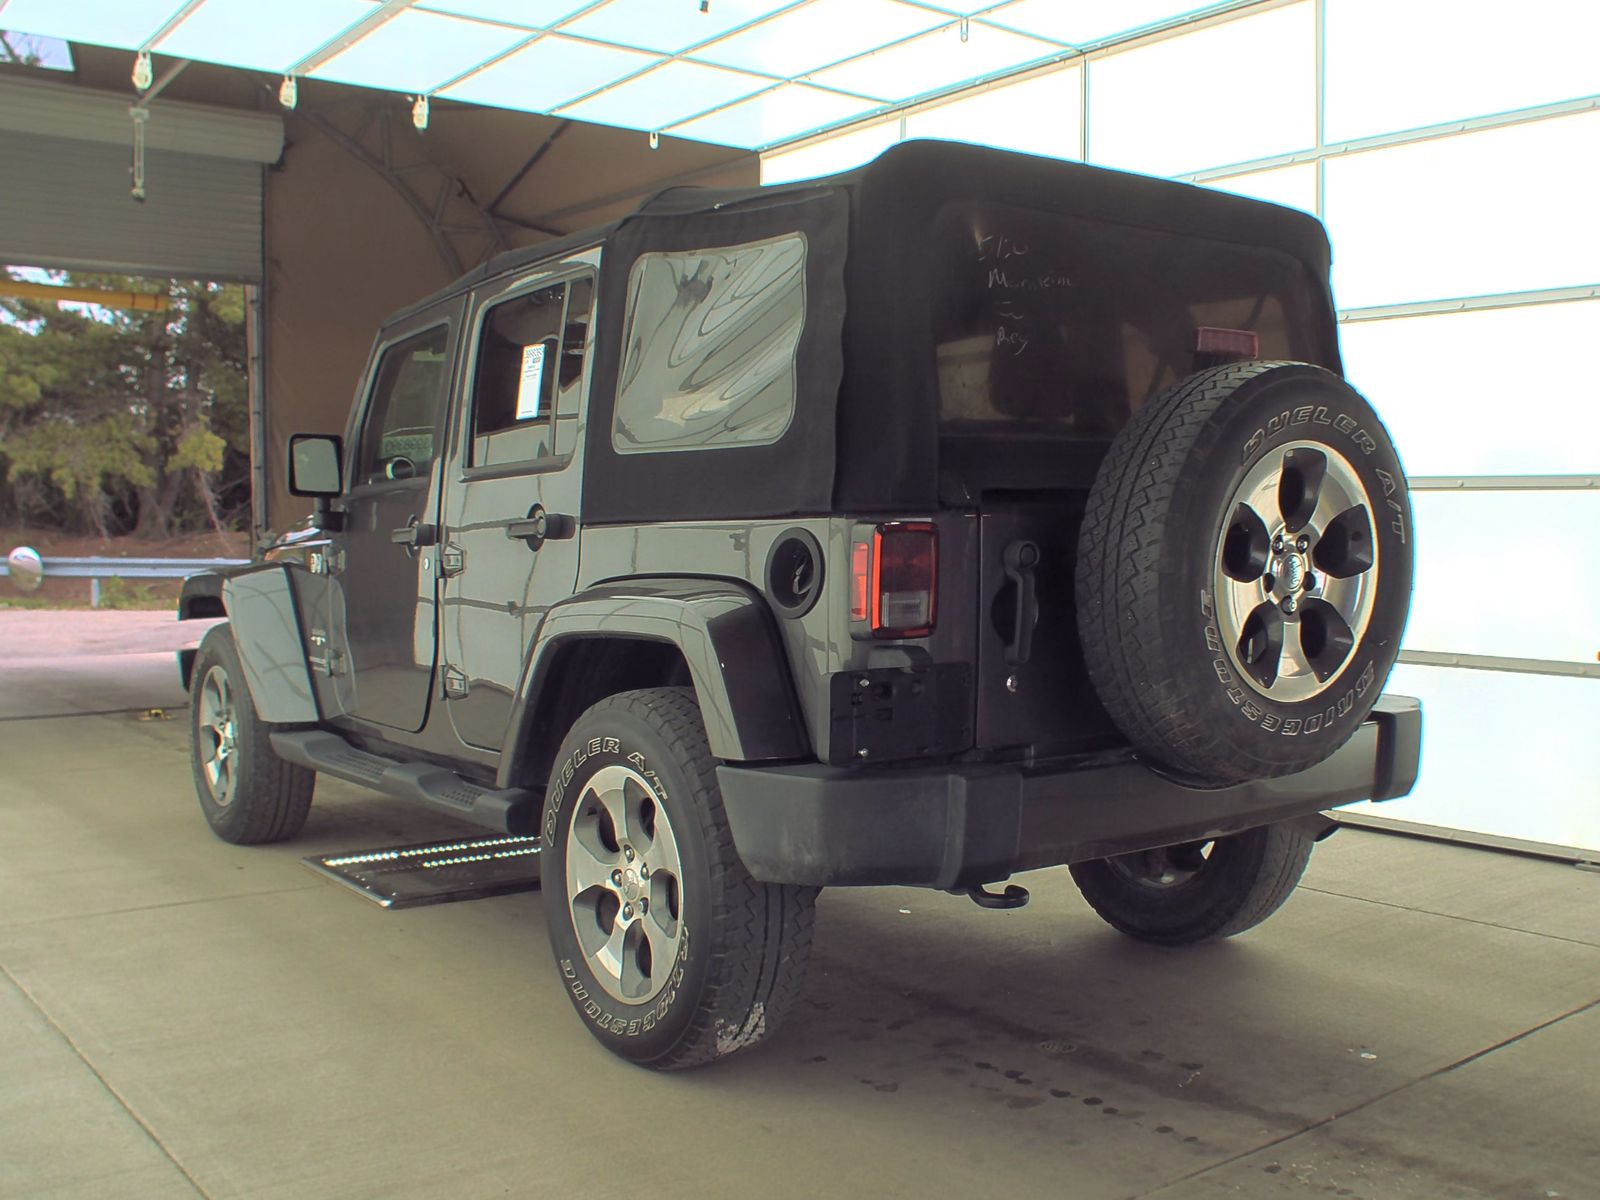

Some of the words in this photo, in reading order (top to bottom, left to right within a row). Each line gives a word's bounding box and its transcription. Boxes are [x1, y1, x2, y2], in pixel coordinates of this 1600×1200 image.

[1241, 405, 1377, 466] DUELER
[1375, 468, 1406, 544] A/T
[1200, 589, 1375, 735] BRIDGESTONE
[545, 737, 620, 847] DUELER
[627, 752, 669, 800] A/T
[560, 926, 689, 1036] BRIDGESTONE
